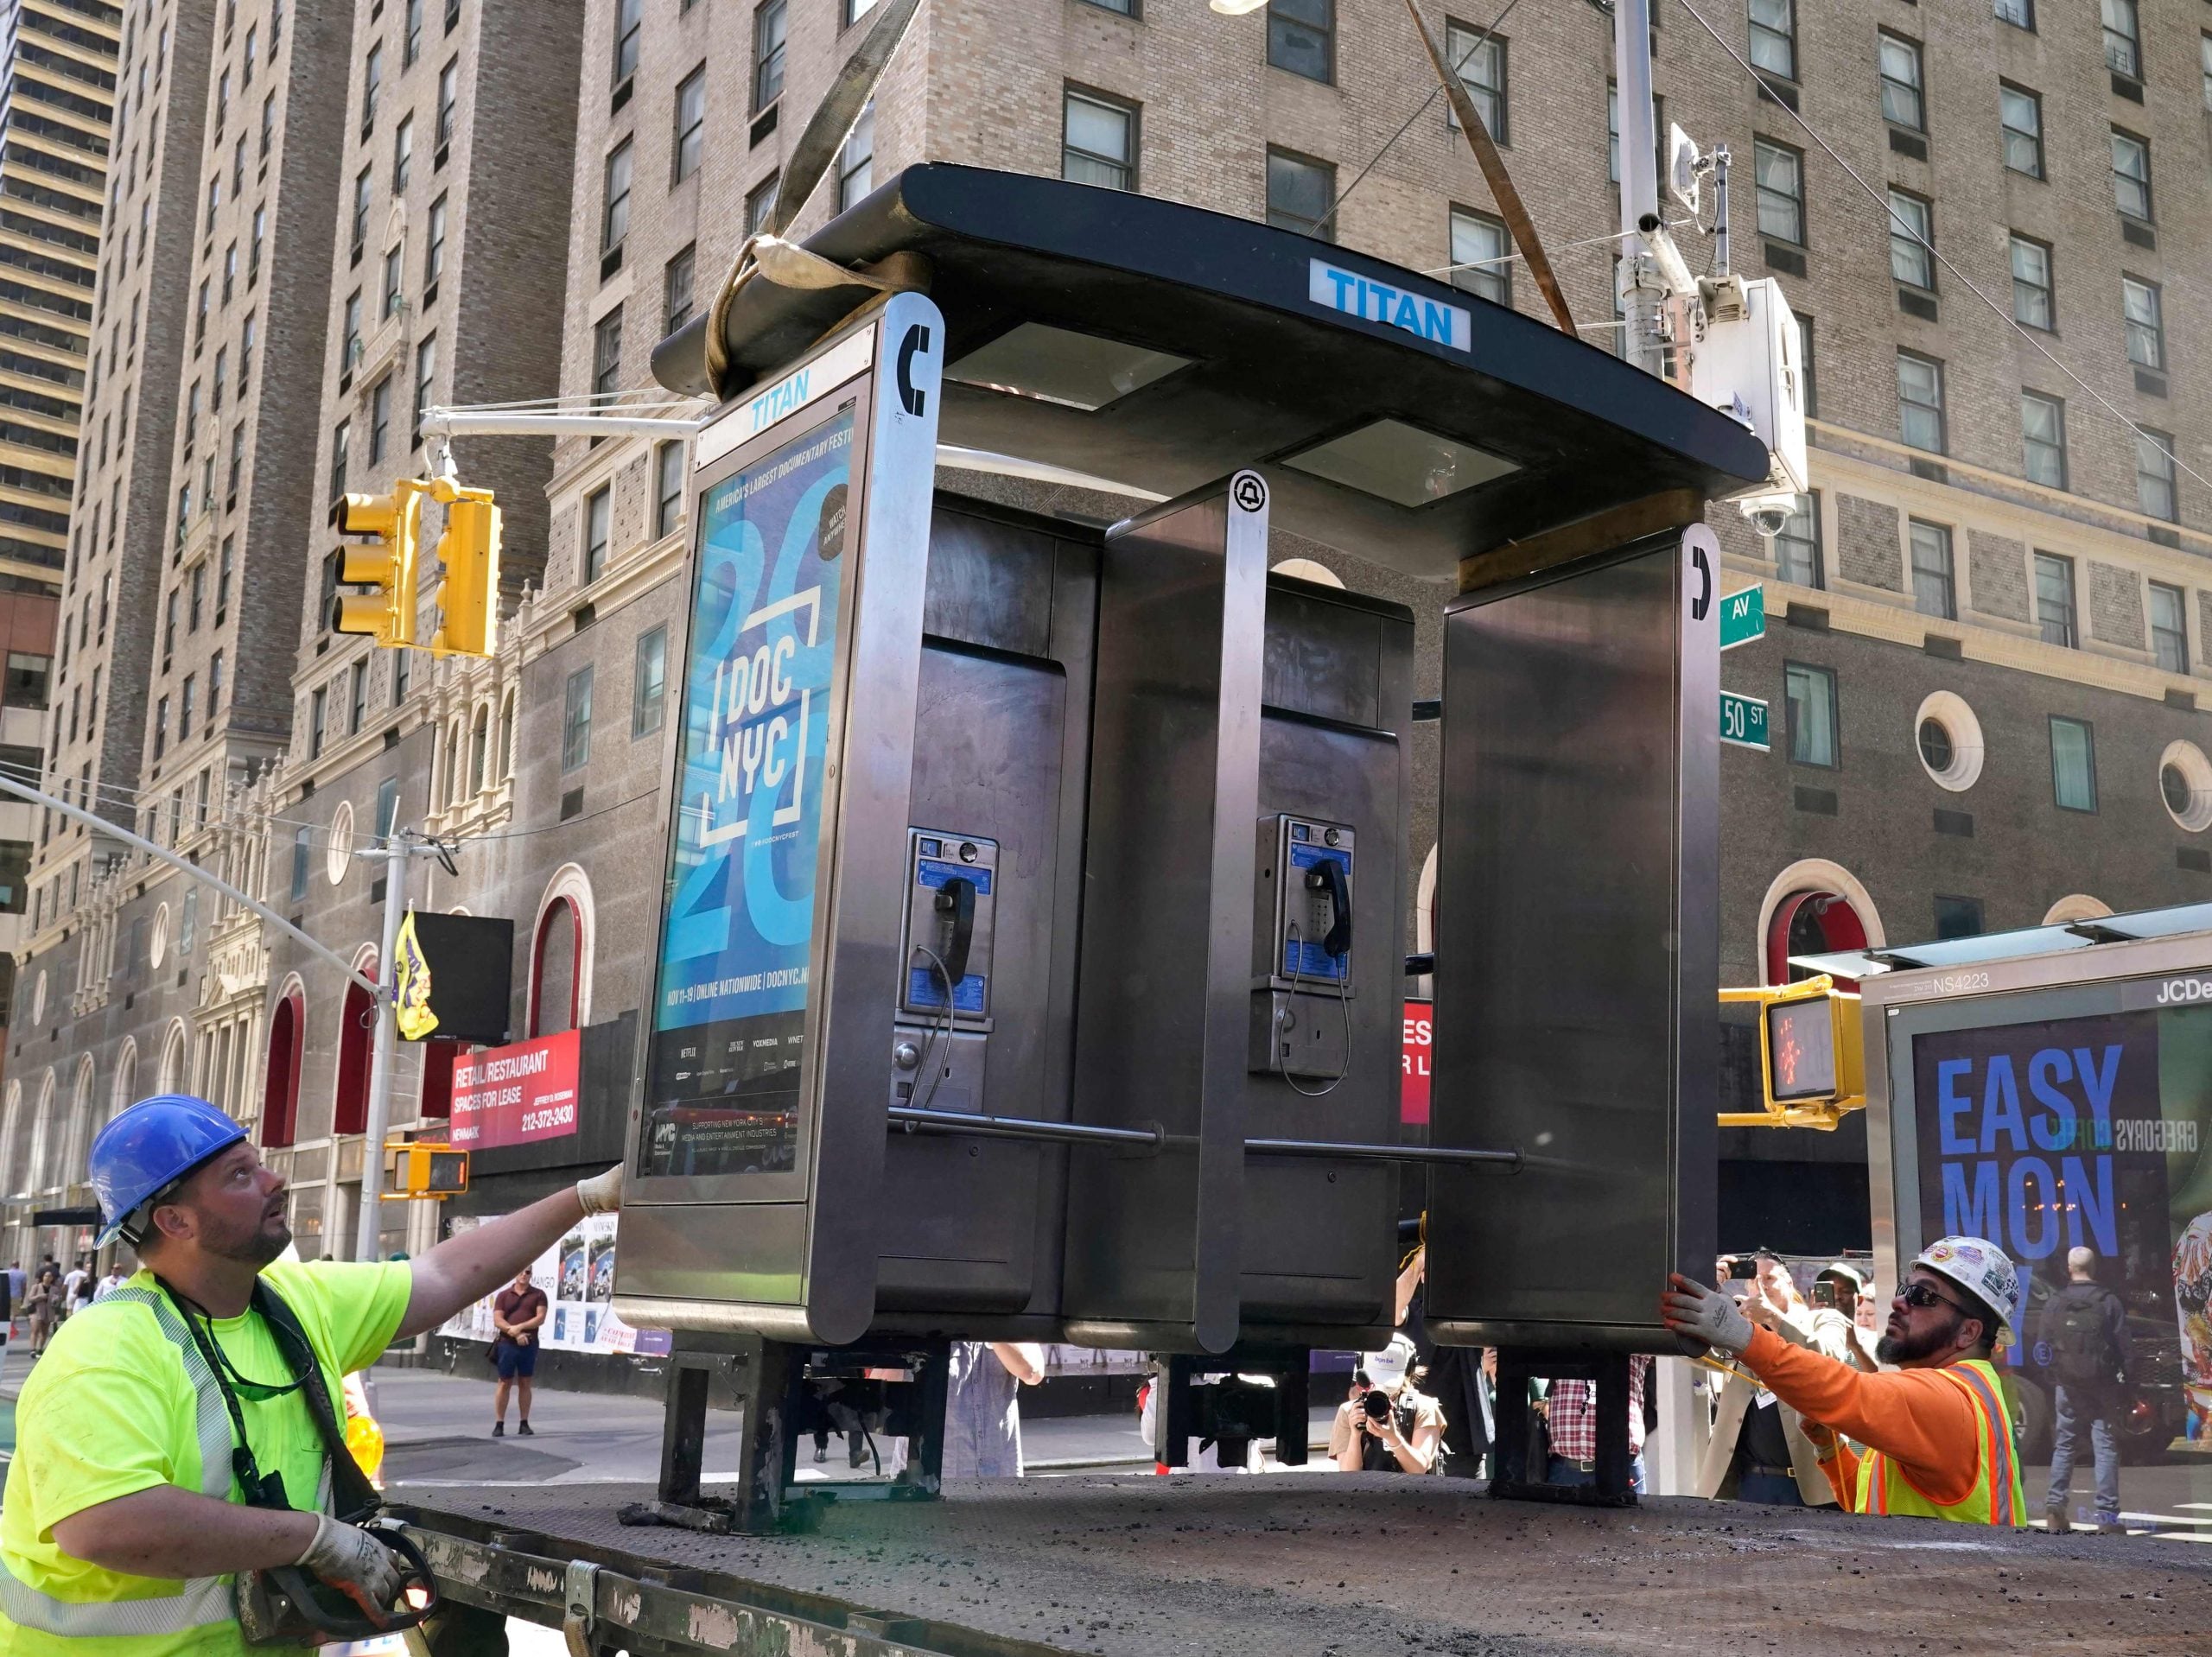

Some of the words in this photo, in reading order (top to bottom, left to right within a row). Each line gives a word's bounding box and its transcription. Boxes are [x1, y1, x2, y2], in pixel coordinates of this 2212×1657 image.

[1326, 269, 1452, 346] TITAN
[751, 368, 810, 431] TITAN
[715, 480, 749, 513] AMERICA'S
[749, 467, 778, 493] LARGEST
[778, 441, 828, 479] DOCUMENTARY
[1732, 594, 1750, 620] AV
[727, 635, 795, 725] DOC
[1725, 699, 1745, 738] 50
[1751, 705, 1764, 726] ST
[718, 716, 788, 803] NYC
[667, 988, 679, 1006] NOV
[696, 981, 718, 1000] ONLINE
[719, 974, 762, 996] NATIONWIDE
[1933, 973, 1989, 994] NS4223
[455, 1049, 549, 1089] RETAIL/RESTAURANT
[454, 1093, 481, 1114] SPACES
[481, 1090, 497, 1108] FOR
[499, 1086, 522, 1106] LEASE
[522, 1104, 574, 1133] 212-372-2430
[1938, 1044, 2123, 1155] EASY
[452, 1126, 480, 1142] NEWMARK
[1942, 1154, 2119, 1260] MON
